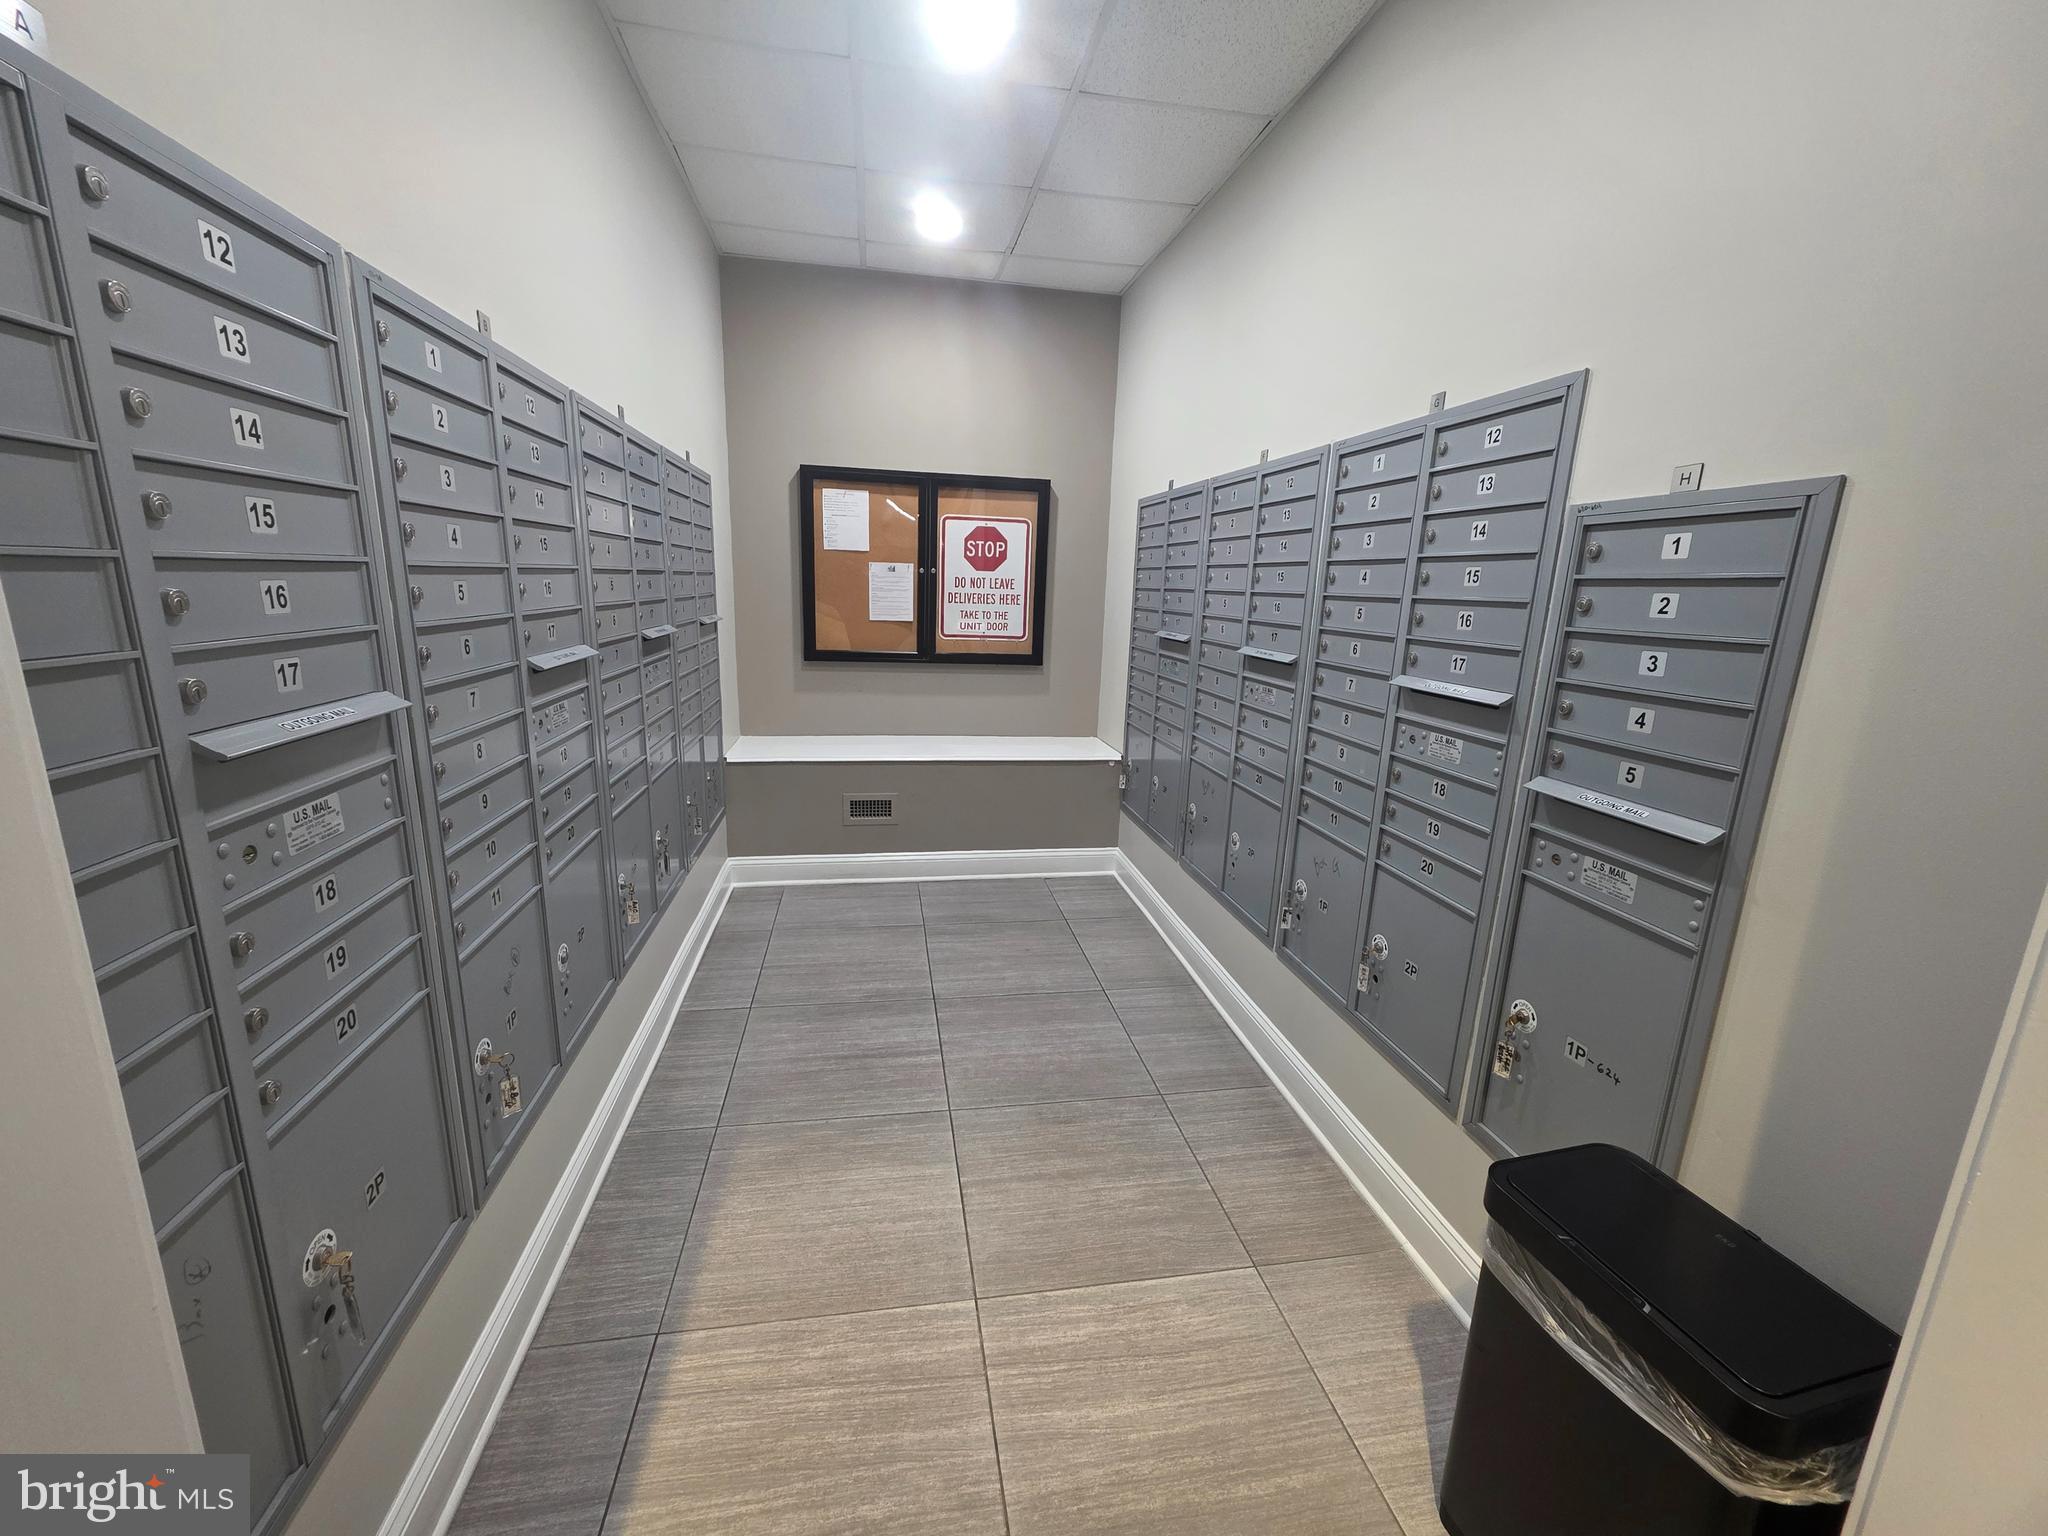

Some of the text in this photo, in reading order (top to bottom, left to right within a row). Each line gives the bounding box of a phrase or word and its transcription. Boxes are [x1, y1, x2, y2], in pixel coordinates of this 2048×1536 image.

[14, 9, 34, 41] A
[203, 229, 233, 267] 12
[219, 325, 247, 358] 13
[430, 349, 437, 367] 1
[526, 395, 535, 414] 12
[1434, 398, 1440, 408] G
[437, 410, 445, 428] 2
[234, 415, 262, 444] 14
[1487, 428, 1502, 445] 12
[531, 444, 540, 462] 13
[1376, 458, 1382, 468] 1
[444, 470, 452, 487] 3
[601, 472, 605, 484] 2
[1286, 478, 1294, 488] 12
[1480, 476, 1494, 492] 13
[1679, 472, 1692, 486] H
[536, 492, 544, 507] 14
[1232, 491, 1236, 500] 1
[1371, 496, 1376, 508] 2
[249, 502, 275, 528] 15
[1283, 510, 1290, 520] 13
[1230, 519, 1234, 528] 2
[451, 530, 458, 545] 4
[1473, 524, 1486, 538] 14
[540, 538, 548, 551] 15
[1280, 542, 1288, 550] 14
[1366, 534, 1372, 546] 3
[1672, 536, 1682, 556] 1
[966, 540, 1006, 558] STOP
[1228, 546, 1232, 555] 3
[954, 576, 1015, 590] DO NOT LEAVE
[1226, 572, 1229, 582] 4
[1277, 572, 1284, 582] 15
[1362, 572, 1367, 582] 4
[1466, 570, 1480, 584] 15
[458, 584, 464, 601] 5
[544, 582, 552, 595] 16
[610, 580, 614, 591] 5
[264, 584, 288, 609] 16
[948, 592, 1020, 606] DELIVERIES HERE
[1223, 600, 1227, 608] 5
[1274, 602, 1281, 612] 16
[1657, 596, 1671, 615] 2
[960, 610, 1008, 621] TAKE TO THE
[1357, 608, 1362, 619] 5
[1459, 613, 1472, 628] 16
[548, 625, 556, 640] 17
[960, 622, 1008, 632] UNIT DOOR
[1221, 624, 1224, 634] 6
[1271, 632, 1278, 642] 17
[464, 639, 470, 654] 6
[1352, 644, 1358, 654] 6
[1218, 651, 1222, 660] 7
[1452, 657, 1466, 672] 17
[1646, 655, 1658, 672] 3
[277, 663, 299, 687] 17
[1348, 680, 1354, 691] 7
[470, 692, 476, 707] 7
[281, 714, 335, 729] OUTGOING
[1262, 720, 1268, 728] 18
[1344, 714, 1349, 725] 8
[1634, 712, 1646, 728] 4
[1434, 734, 1444, 744] U.S.
[476, 743, 482, 758] 8
[1209, 752, 1214, 760] 11
[1259, 748, 1266, 756] 19
[1339, 748, 1344, 759] 9
[1255, 774, 1262, 784] 20
[1625, 767, 1637, 784] 5
[1334, 780, 1342, 792] 10
[1434, 782, 1446, 798] 18
[564, 787, 572, 801] 19
[482, 794, 488, 809] 9
[1580, 793, 1646, 818] OUTGOING MAIL
[293, 799, 332, 823] U.S. MAIL
[1330, 814, 1338, 824] 11
[568, 826, 574, 840] 20
[1428, 822, 1440, 837] 19
[486, 840, 496, 858] 10
[1421, 860, 1434, 876] 20
[1592, 860, 1628, 882] U.S. MAIL
[315, 879, 336, 906] 18
[492, 888, 502, 906] 11
[1319, 900, 1328, 911] 1P
[326, 945, 347, 973] 19
[1404, 961, 1418, 976] 2P
[1518, 1001, 1532, 1012] OPEN
[336, 1009, 357, 1041] 20
[506, 1010, 517, 1030] 1P
[365, 1171, 385, 1207] 2P
